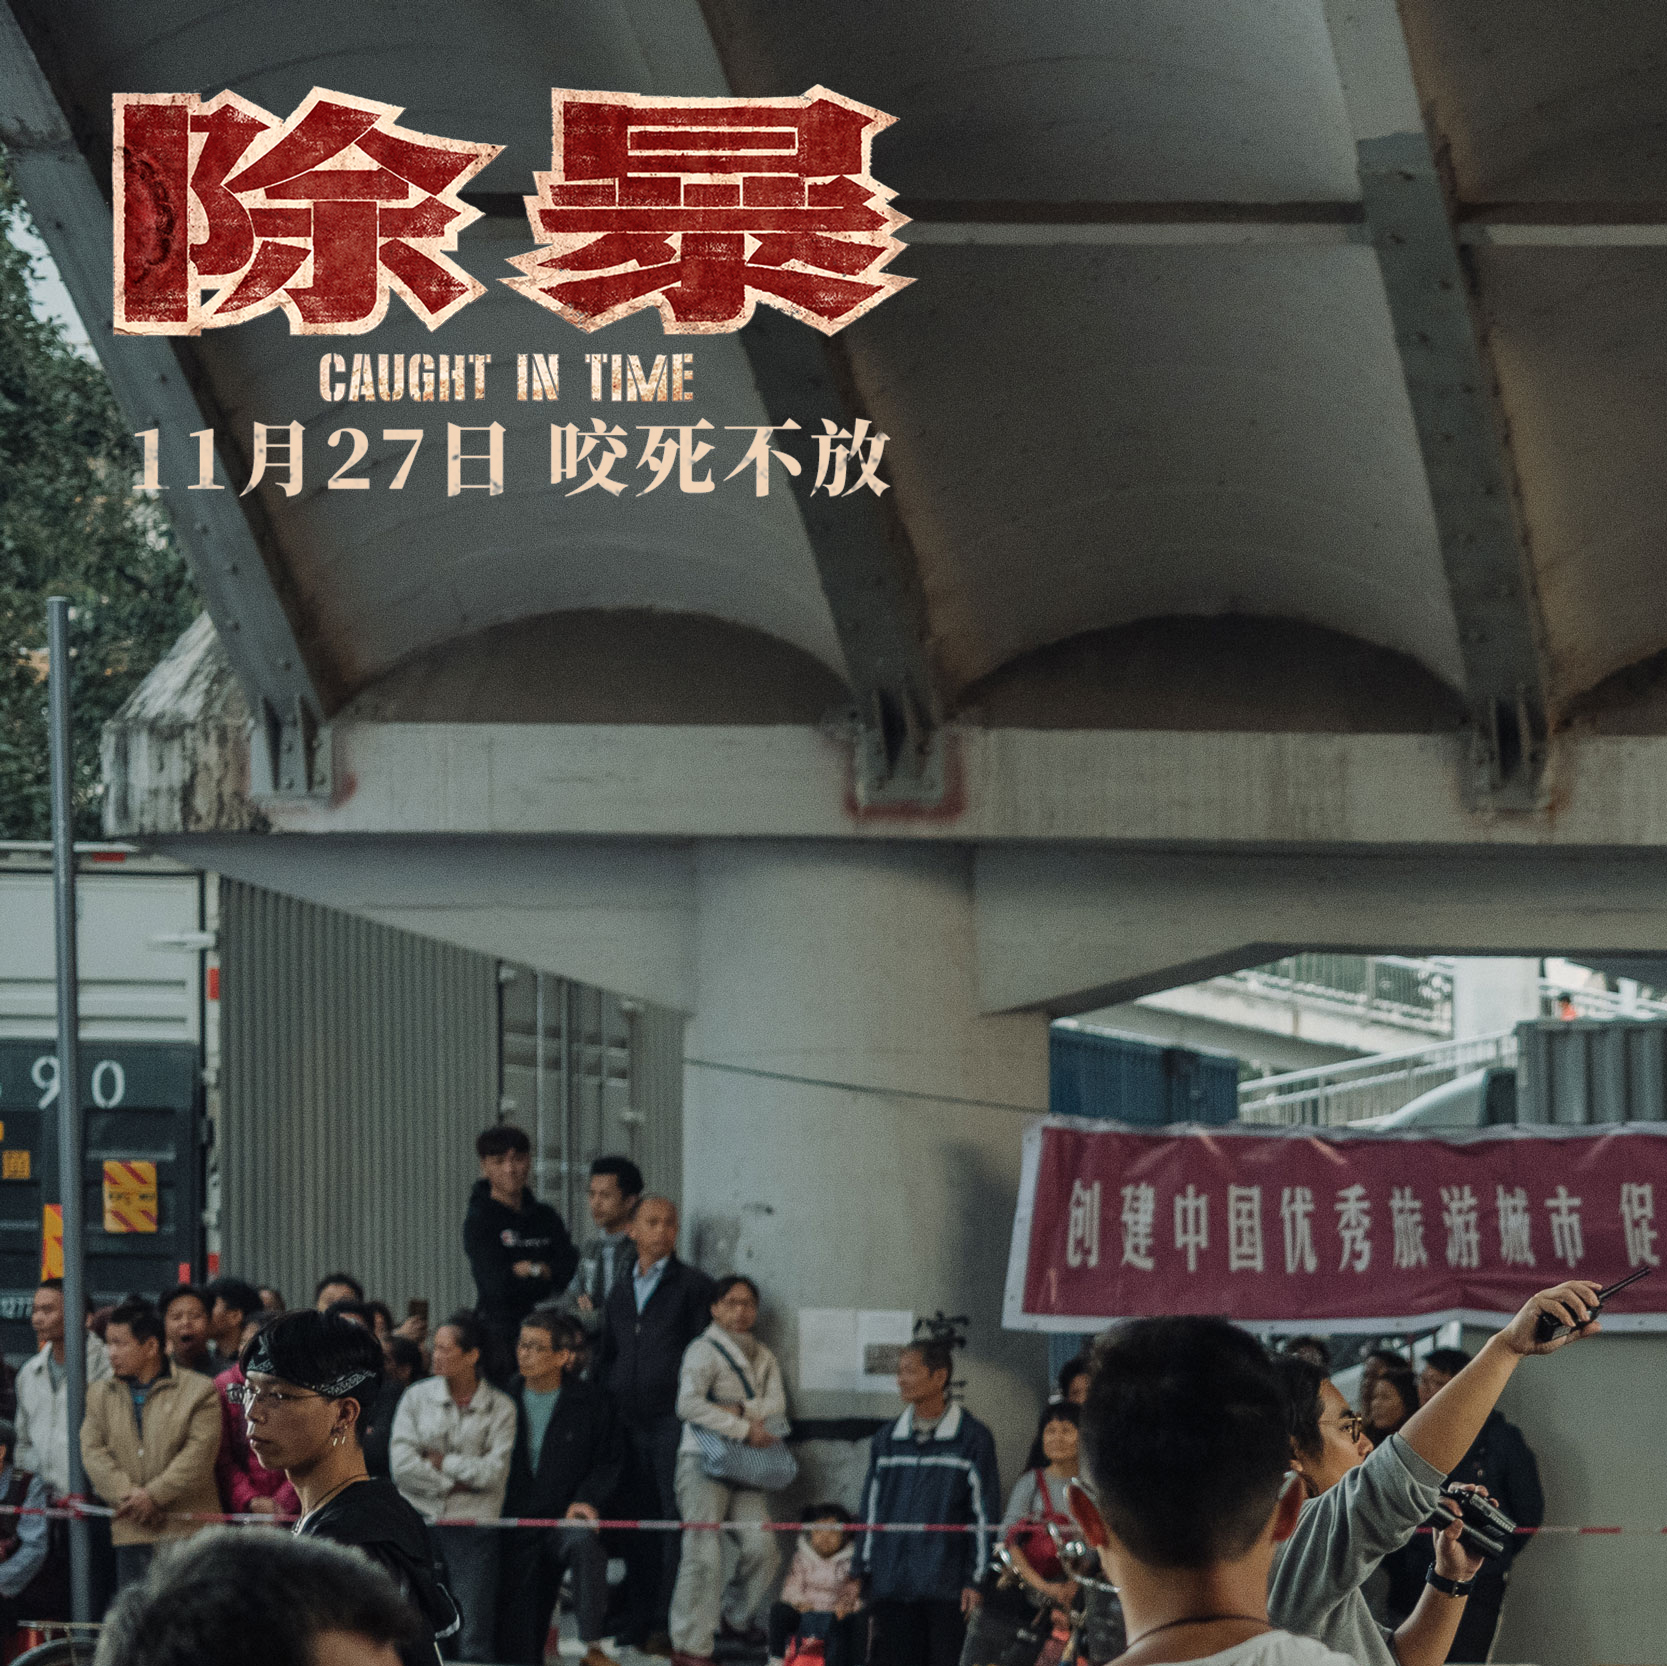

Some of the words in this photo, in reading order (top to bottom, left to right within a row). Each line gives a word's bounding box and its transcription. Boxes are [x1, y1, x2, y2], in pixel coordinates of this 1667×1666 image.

[0, 1055, 125, 1109] 90
[1066, 1178, 1584, 1274] 创建中国优秀旅游城市
